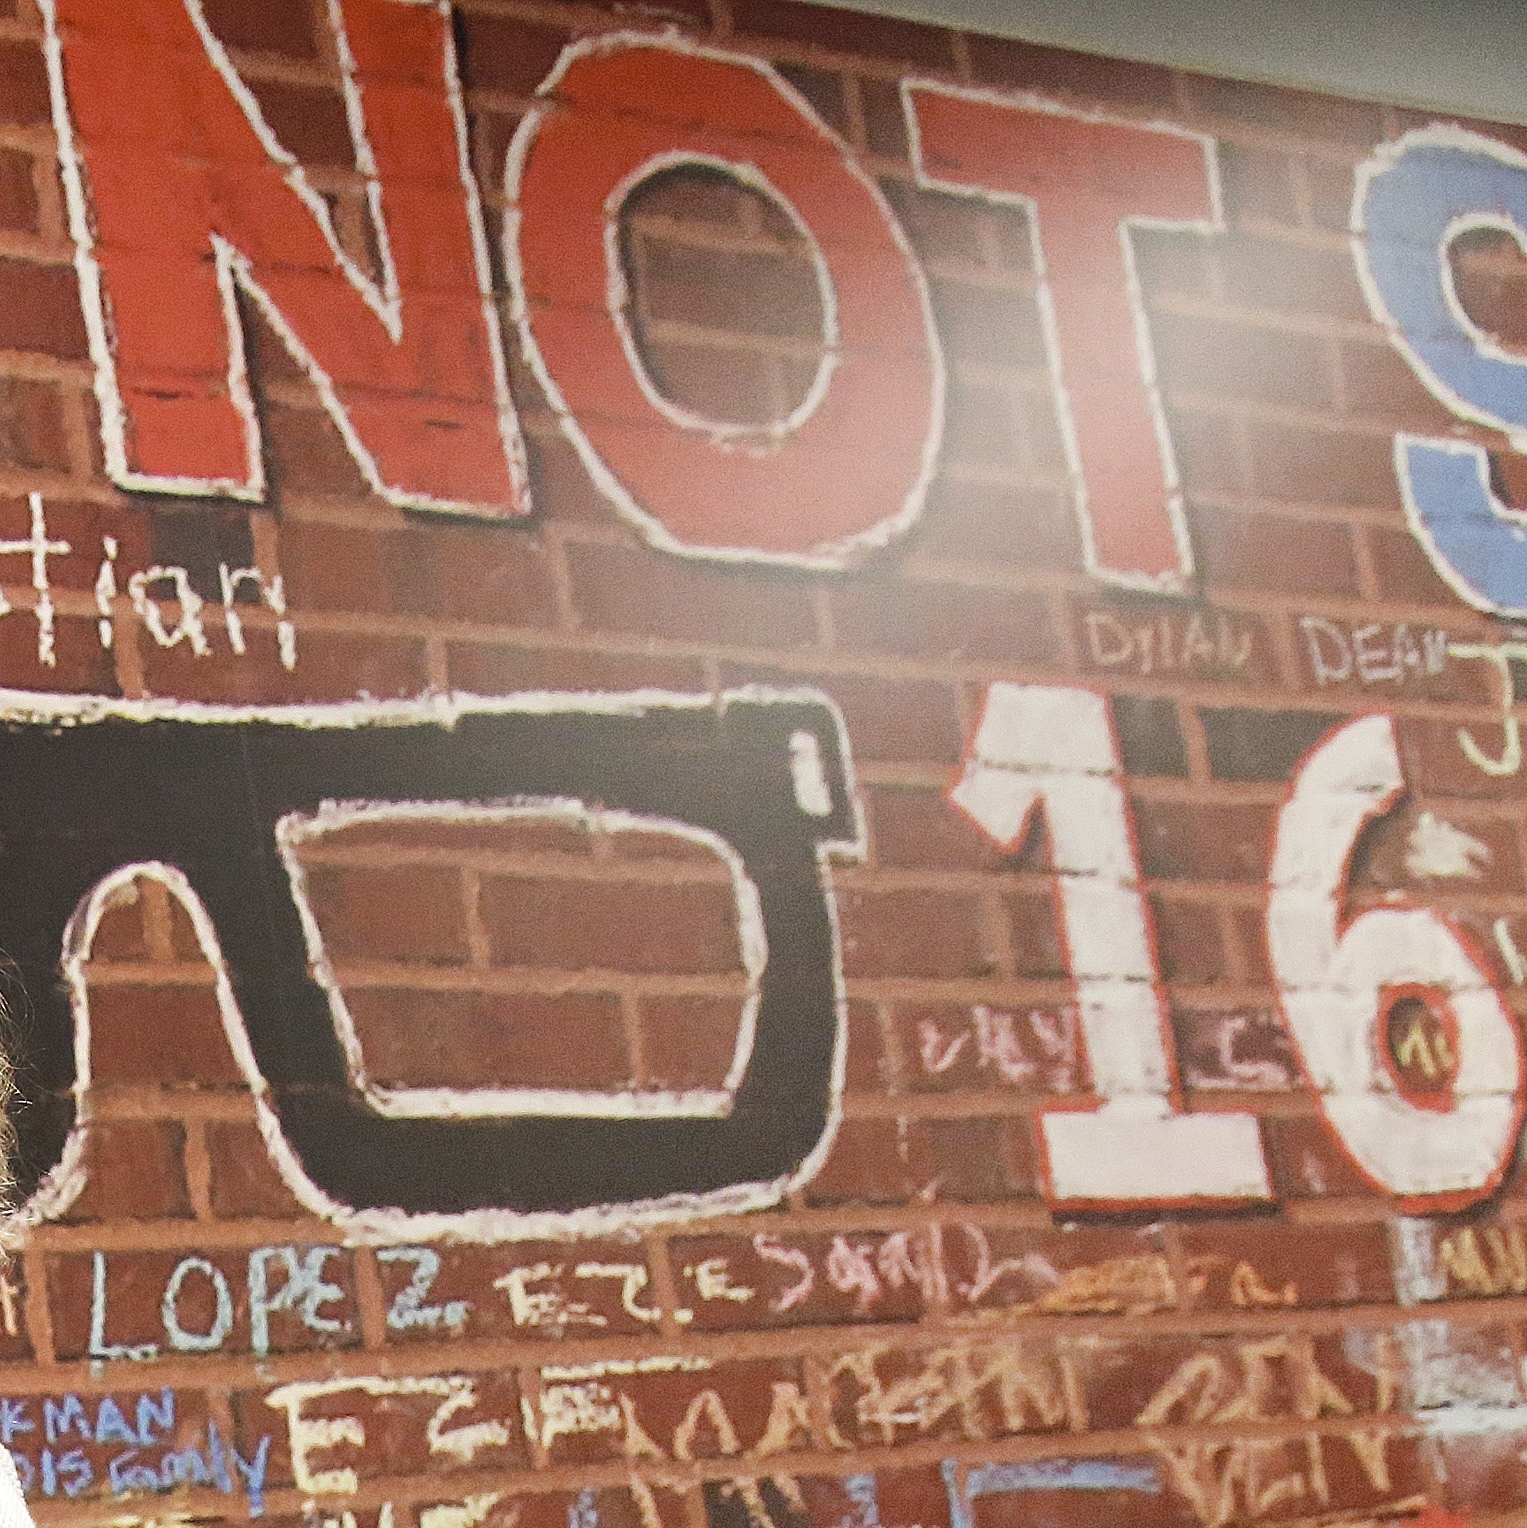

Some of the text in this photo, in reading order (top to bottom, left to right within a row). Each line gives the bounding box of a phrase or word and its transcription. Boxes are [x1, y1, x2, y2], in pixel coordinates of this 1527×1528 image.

[35, 0, 1227, 594] NOT
[945, 678, 1527, 1218] 16
[88, 1243, 469, 1360] LOPEZ
